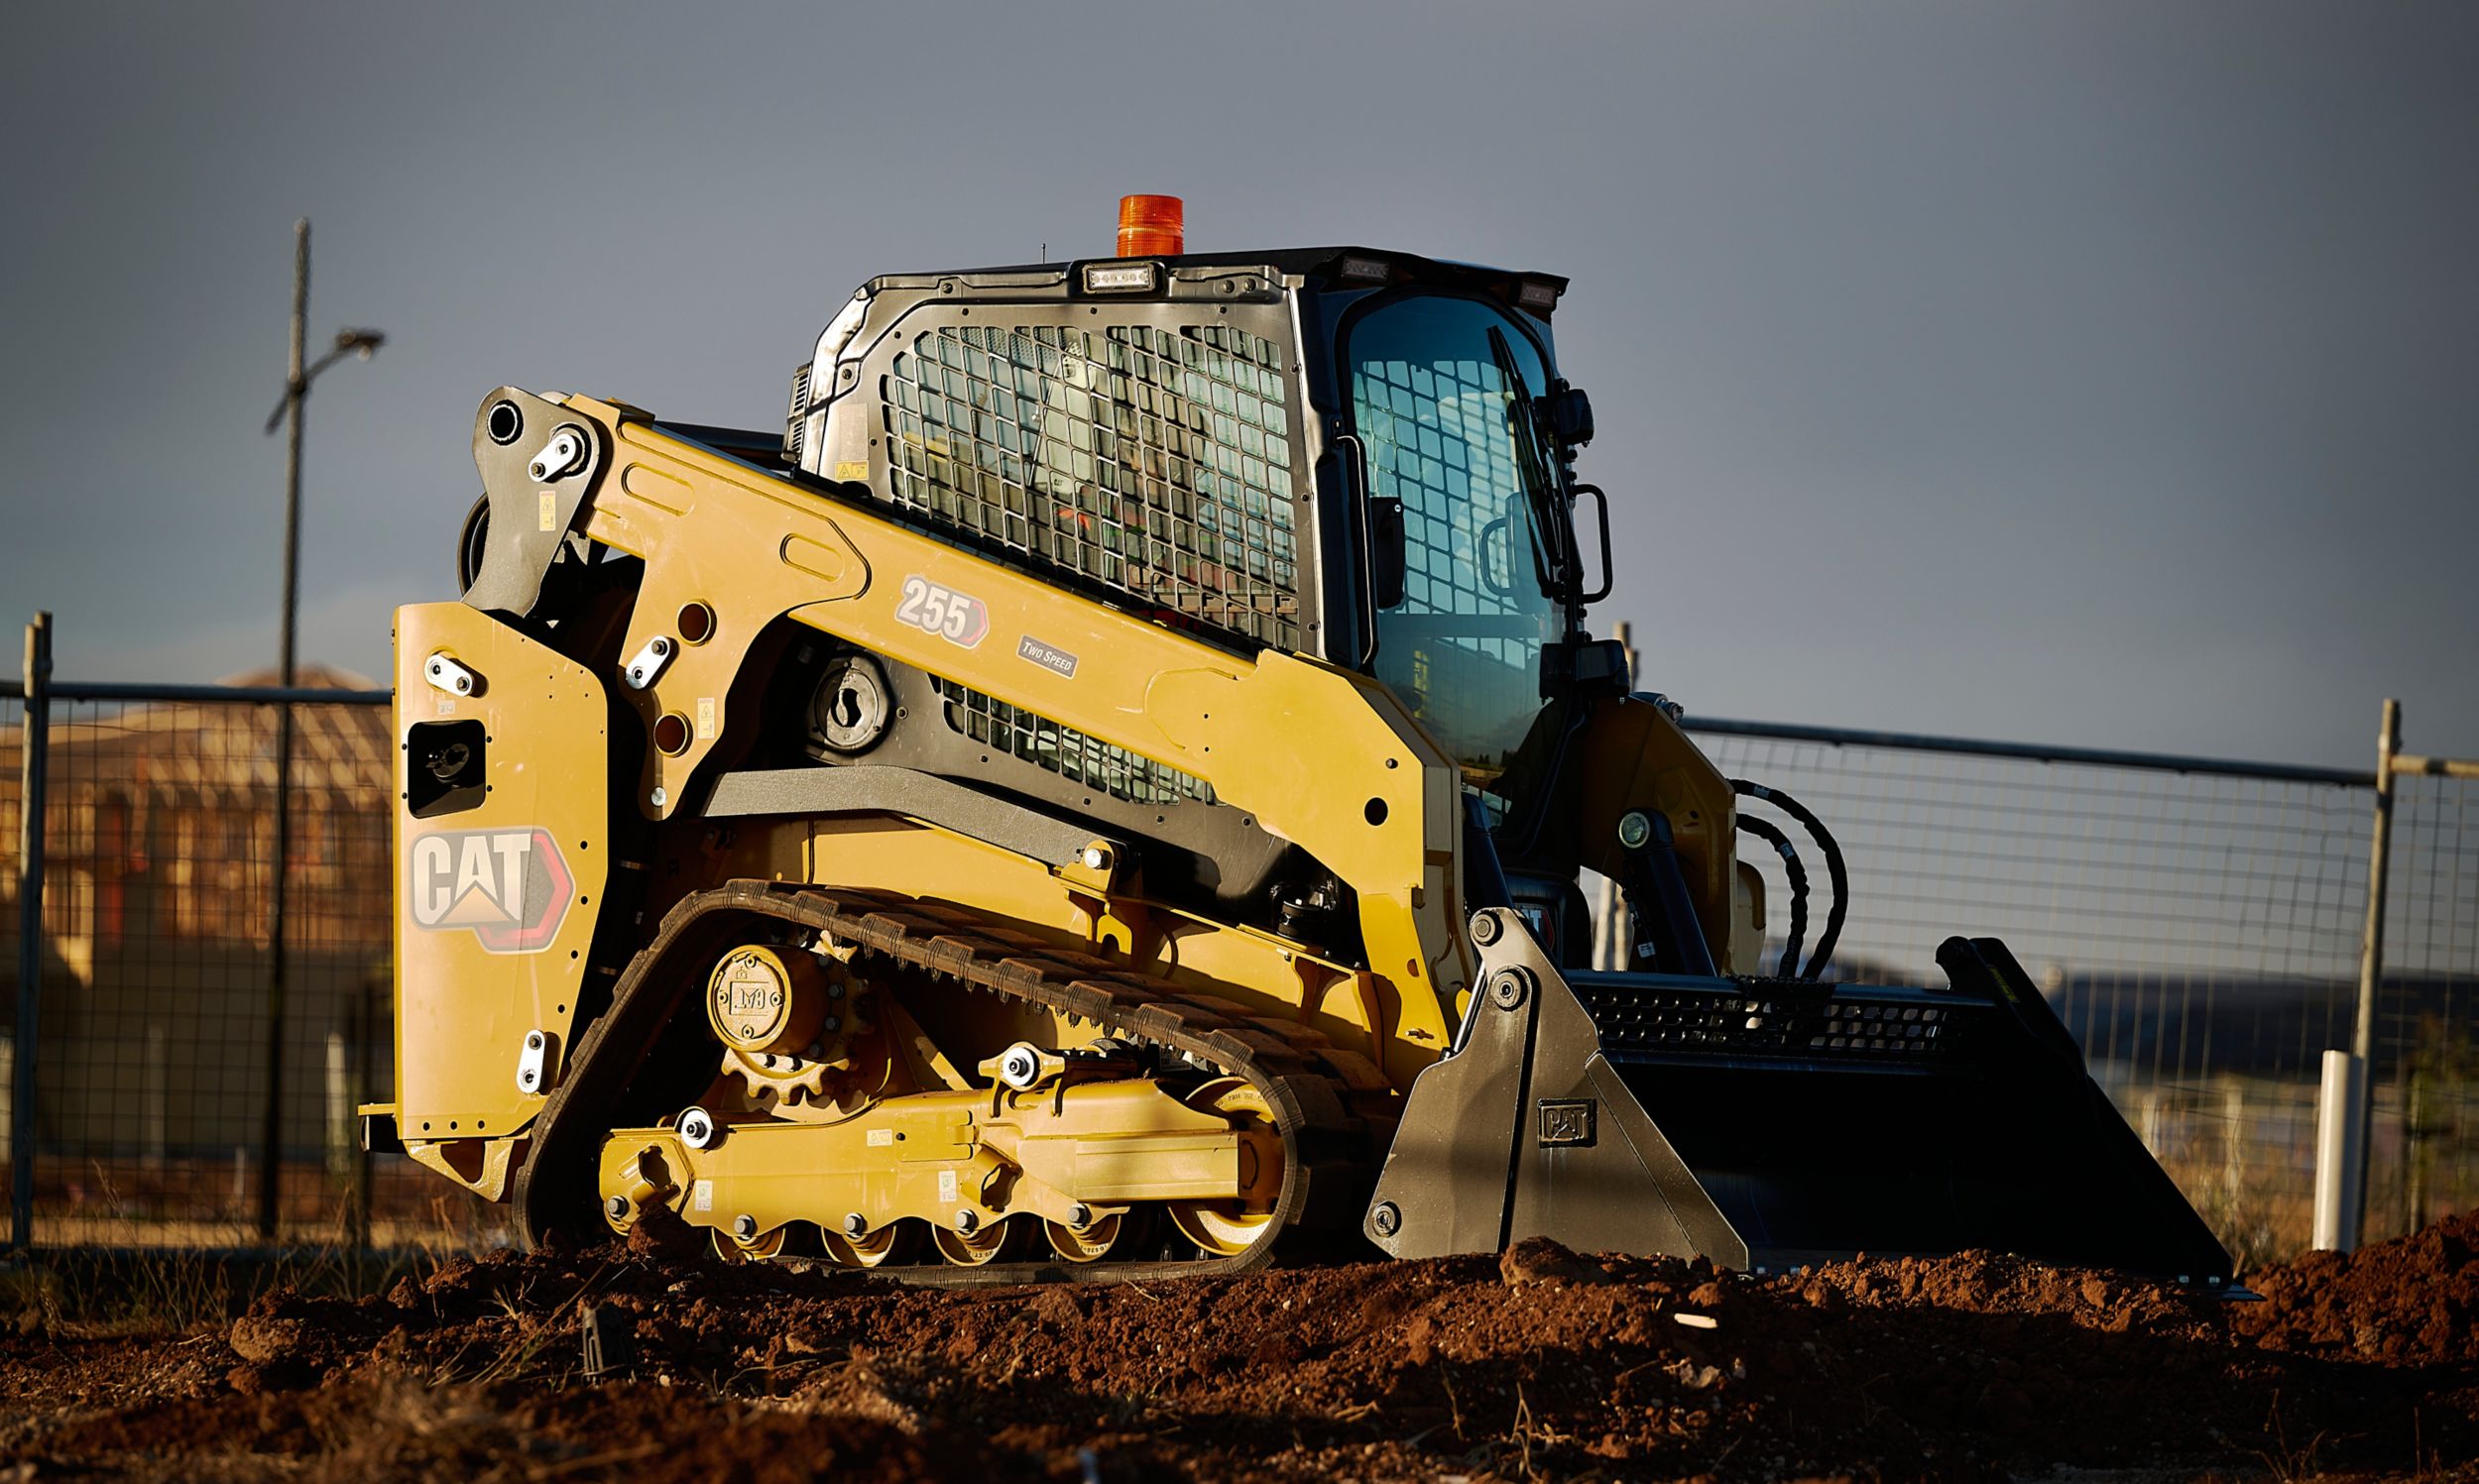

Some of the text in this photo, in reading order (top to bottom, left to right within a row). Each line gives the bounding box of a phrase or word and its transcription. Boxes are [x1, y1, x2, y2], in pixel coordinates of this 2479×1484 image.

[898, 579, 971, 637] 255
[413, 833, 531, 925] CAT
[735, 987, 766, 1009] CAT
[1545, 1108, 1587, 1140] CAT
